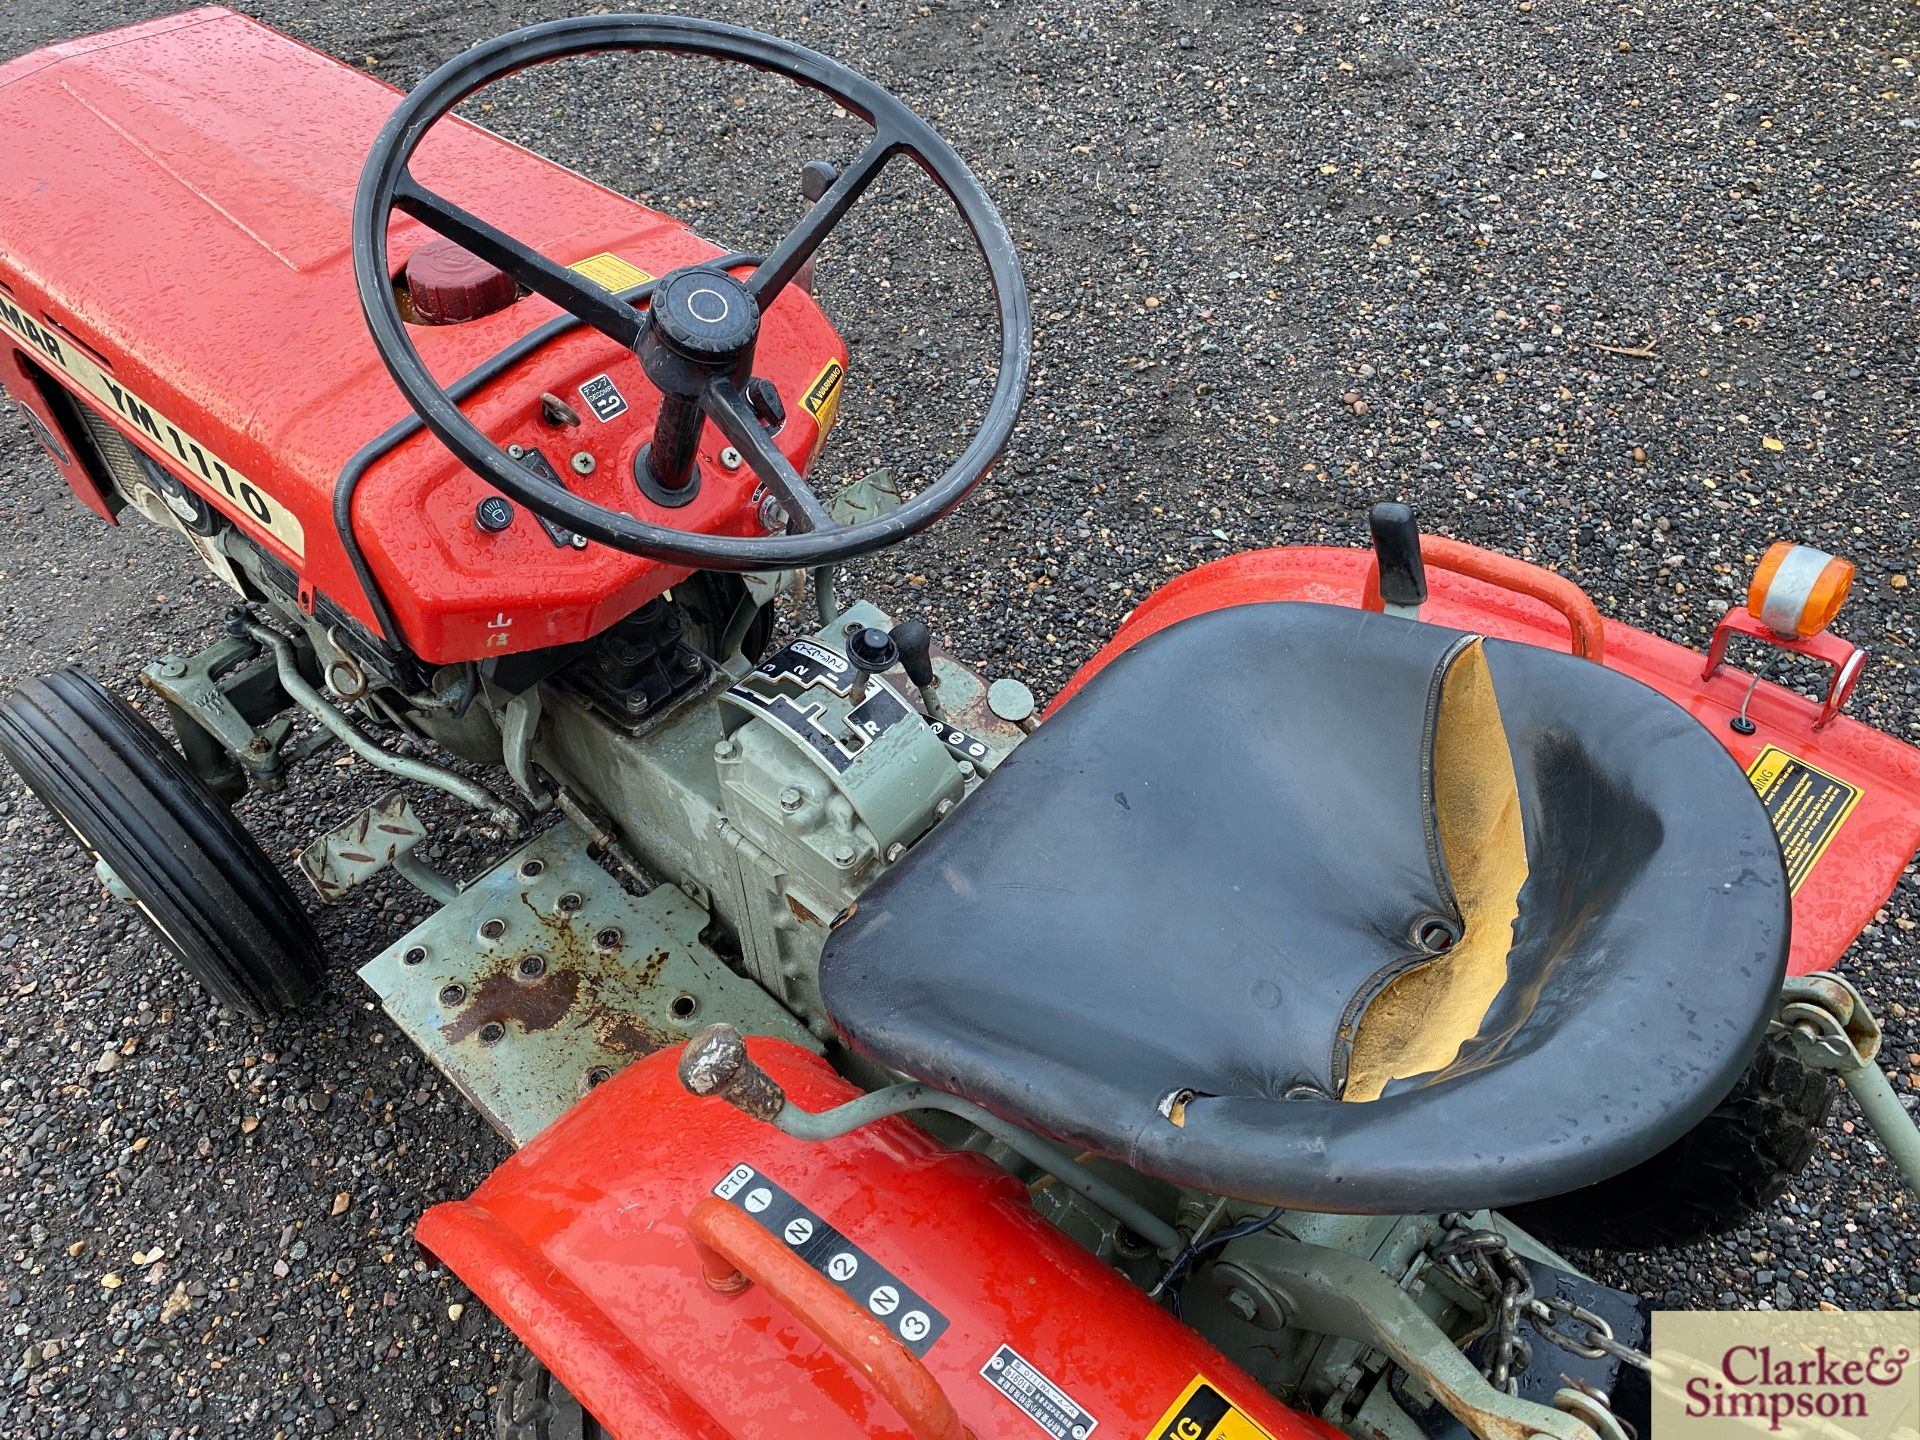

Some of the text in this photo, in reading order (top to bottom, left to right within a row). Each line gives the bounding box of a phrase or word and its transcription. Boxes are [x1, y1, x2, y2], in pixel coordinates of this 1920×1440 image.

[816, 367, 841, 399] WARNING
[762, 663, 777, 672] 3
[793, 665, 809, 675] 2
[863, 720, 881, 736] R
[720, 1168, 749, 1196] PTO
[788, 1222, 810, 1241] N
[833, 1258, 854, 1277] 2
[873, 1290, 896, 1311] N
[905, 1316, 925, 1335] 3
